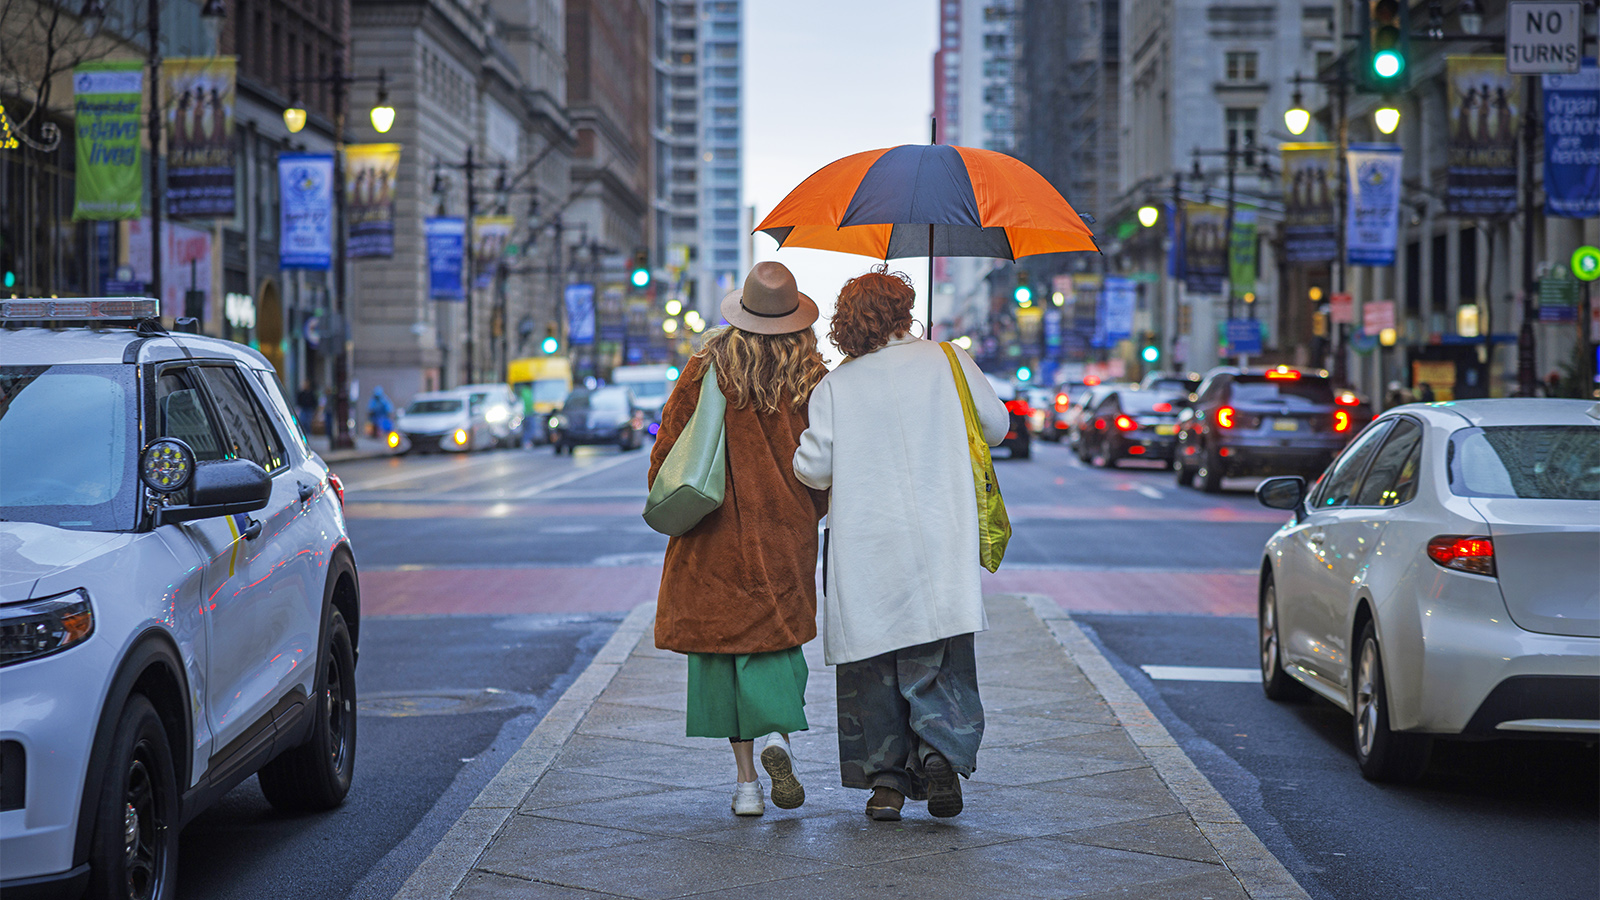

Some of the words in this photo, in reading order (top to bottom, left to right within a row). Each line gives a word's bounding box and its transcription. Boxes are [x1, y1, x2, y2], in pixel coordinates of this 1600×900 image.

[1526, 10, 1562, 34] NO
[1512, 43, 1577, 63] TURNS
[1548, 92, 1598, 119] Organ
[90, 142, 136, 166] lives
[1557, 136, 1582, 149] are
